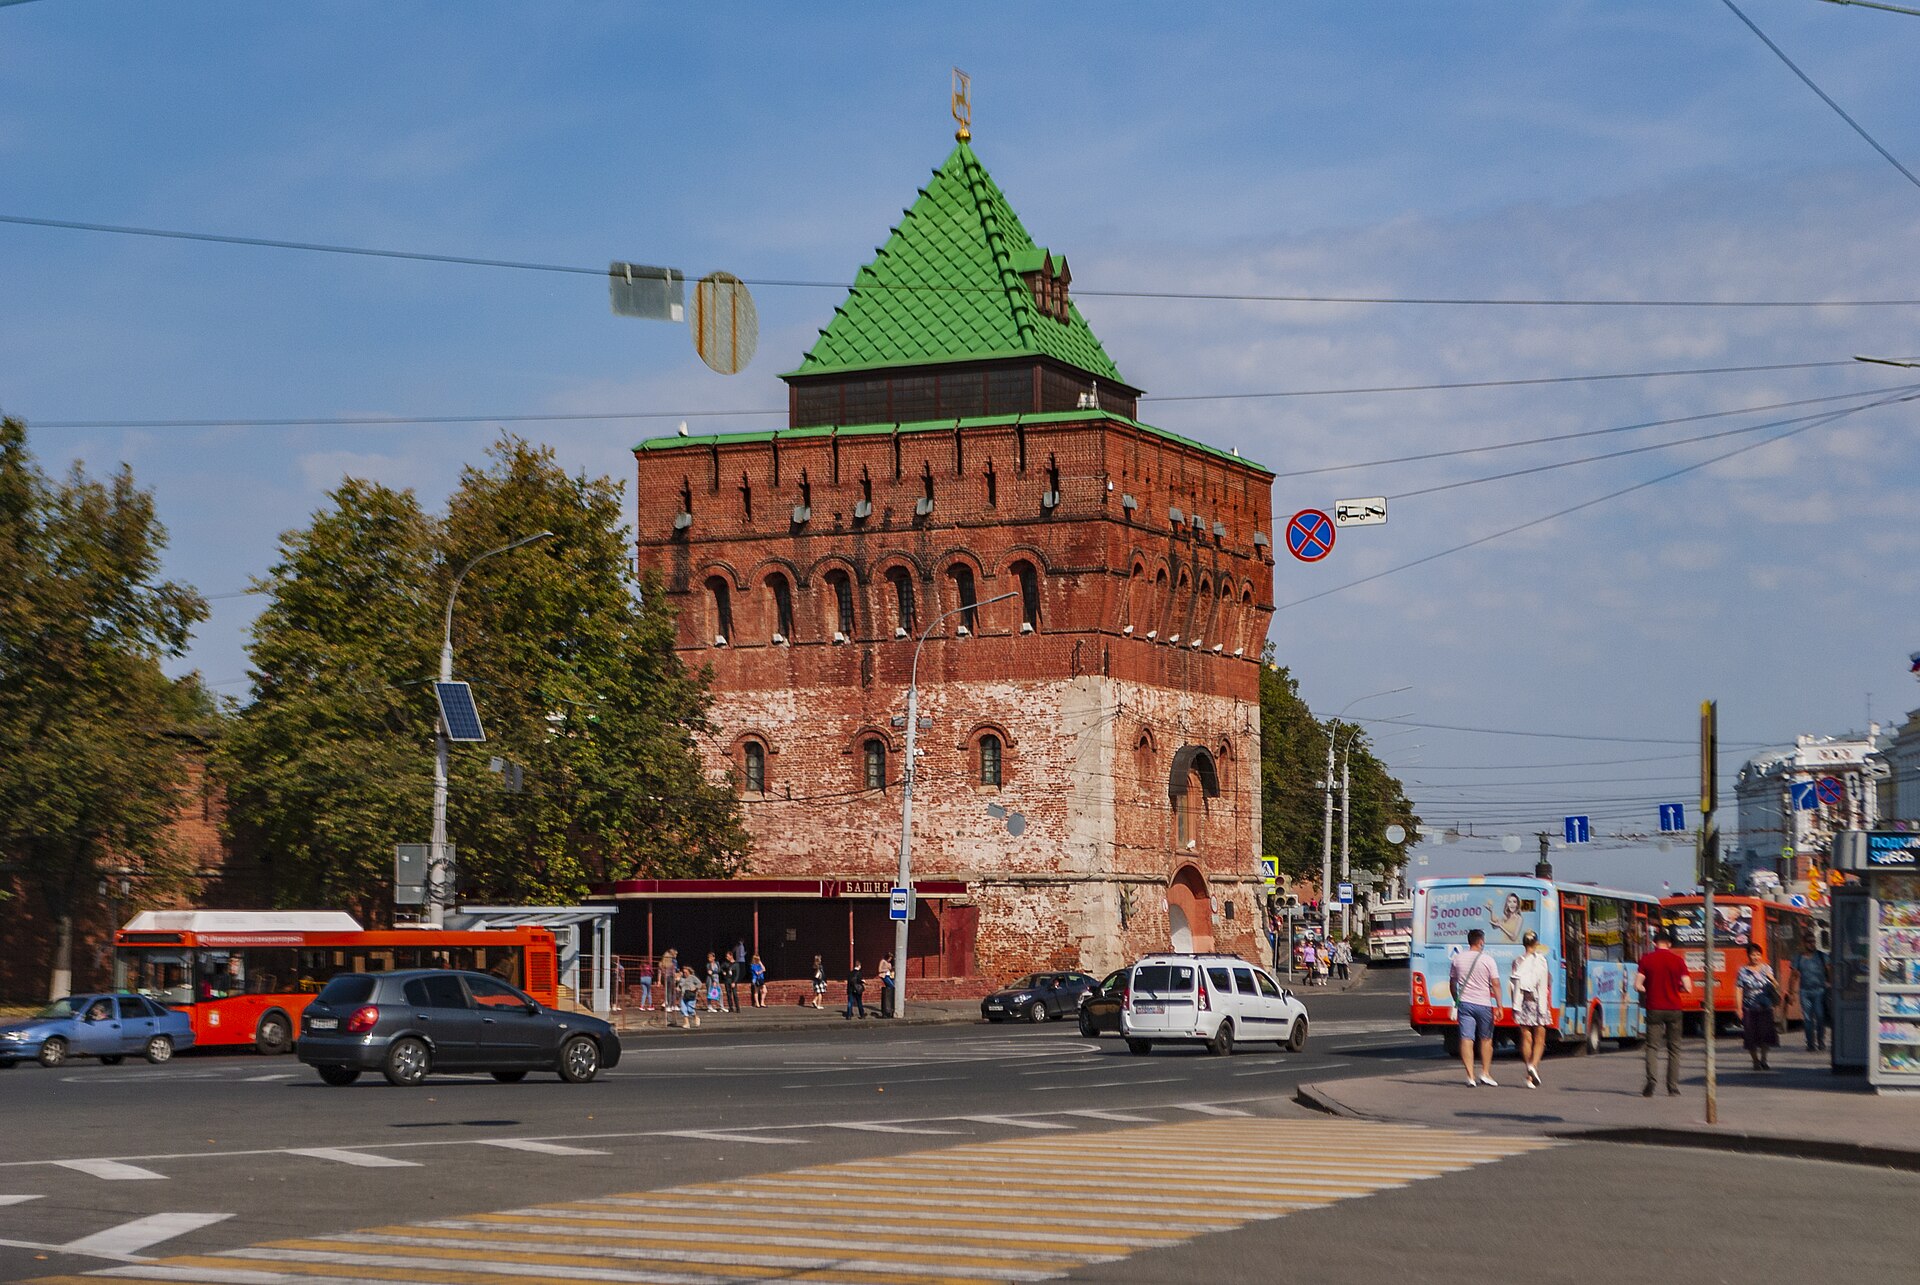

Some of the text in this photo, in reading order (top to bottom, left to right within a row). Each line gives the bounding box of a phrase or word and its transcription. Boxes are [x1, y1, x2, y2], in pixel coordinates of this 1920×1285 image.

[1870, 850, 1915, 864] ЗДЕСЬ
[846, 882, 889, 893] БАШНЯ
[1431, 893, 1470, 905] КРЕДИТ
[1430, 906, 1482, 919] 5 000 000
